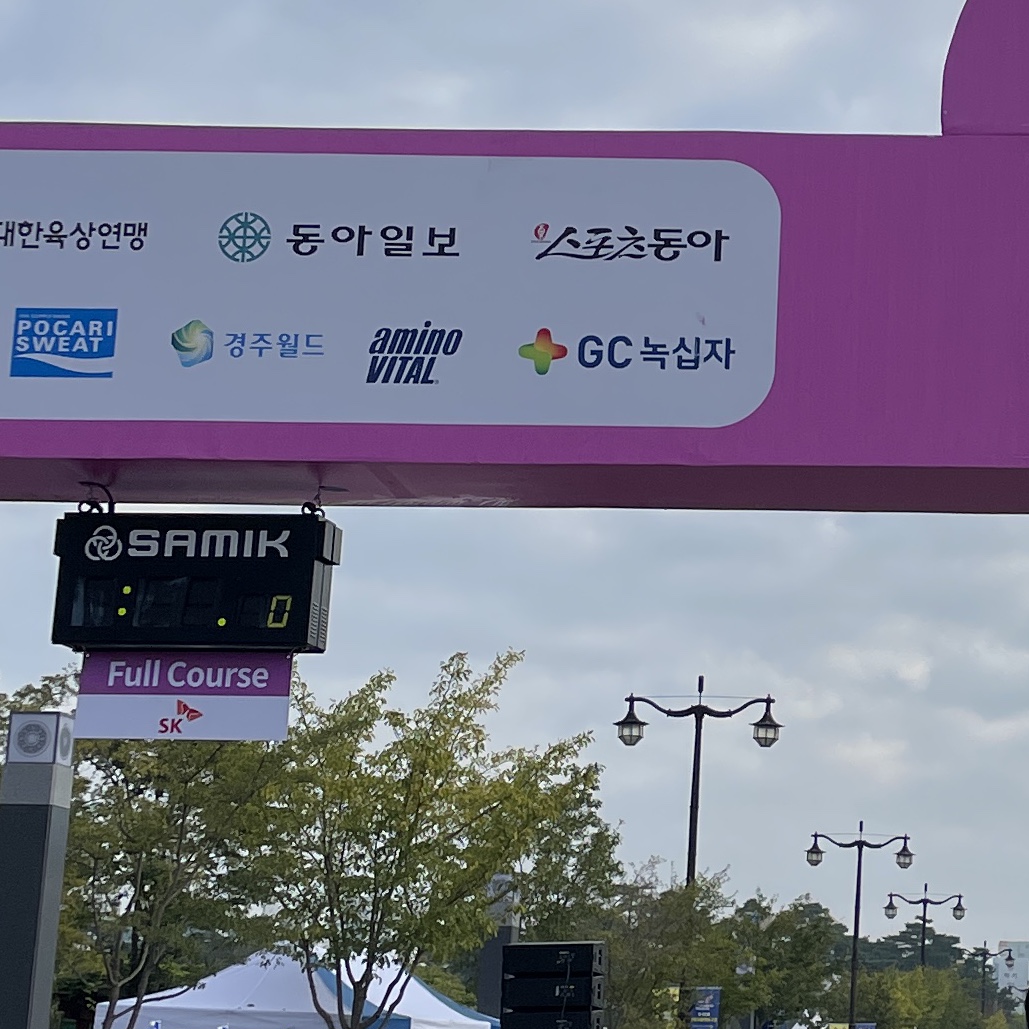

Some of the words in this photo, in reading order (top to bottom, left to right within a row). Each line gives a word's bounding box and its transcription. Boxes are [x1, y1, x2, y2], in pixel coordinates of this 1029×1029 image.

[286, 223, 460, 257] 동아일보
[535, 225, 730, 262] 스포츠동아
[17, 319, 114, 337] POCARI
[369, 320, 463, 356] amino
[15, 336, 104, 353] SWEAT
[223, 332, 325, 358] 경주월드
[128, 529, 291, 558] SAMIK
[107, 660, 161, 688] Full
[166, 661, 270, 689] Course
[158, 718, 183, 735] SK
